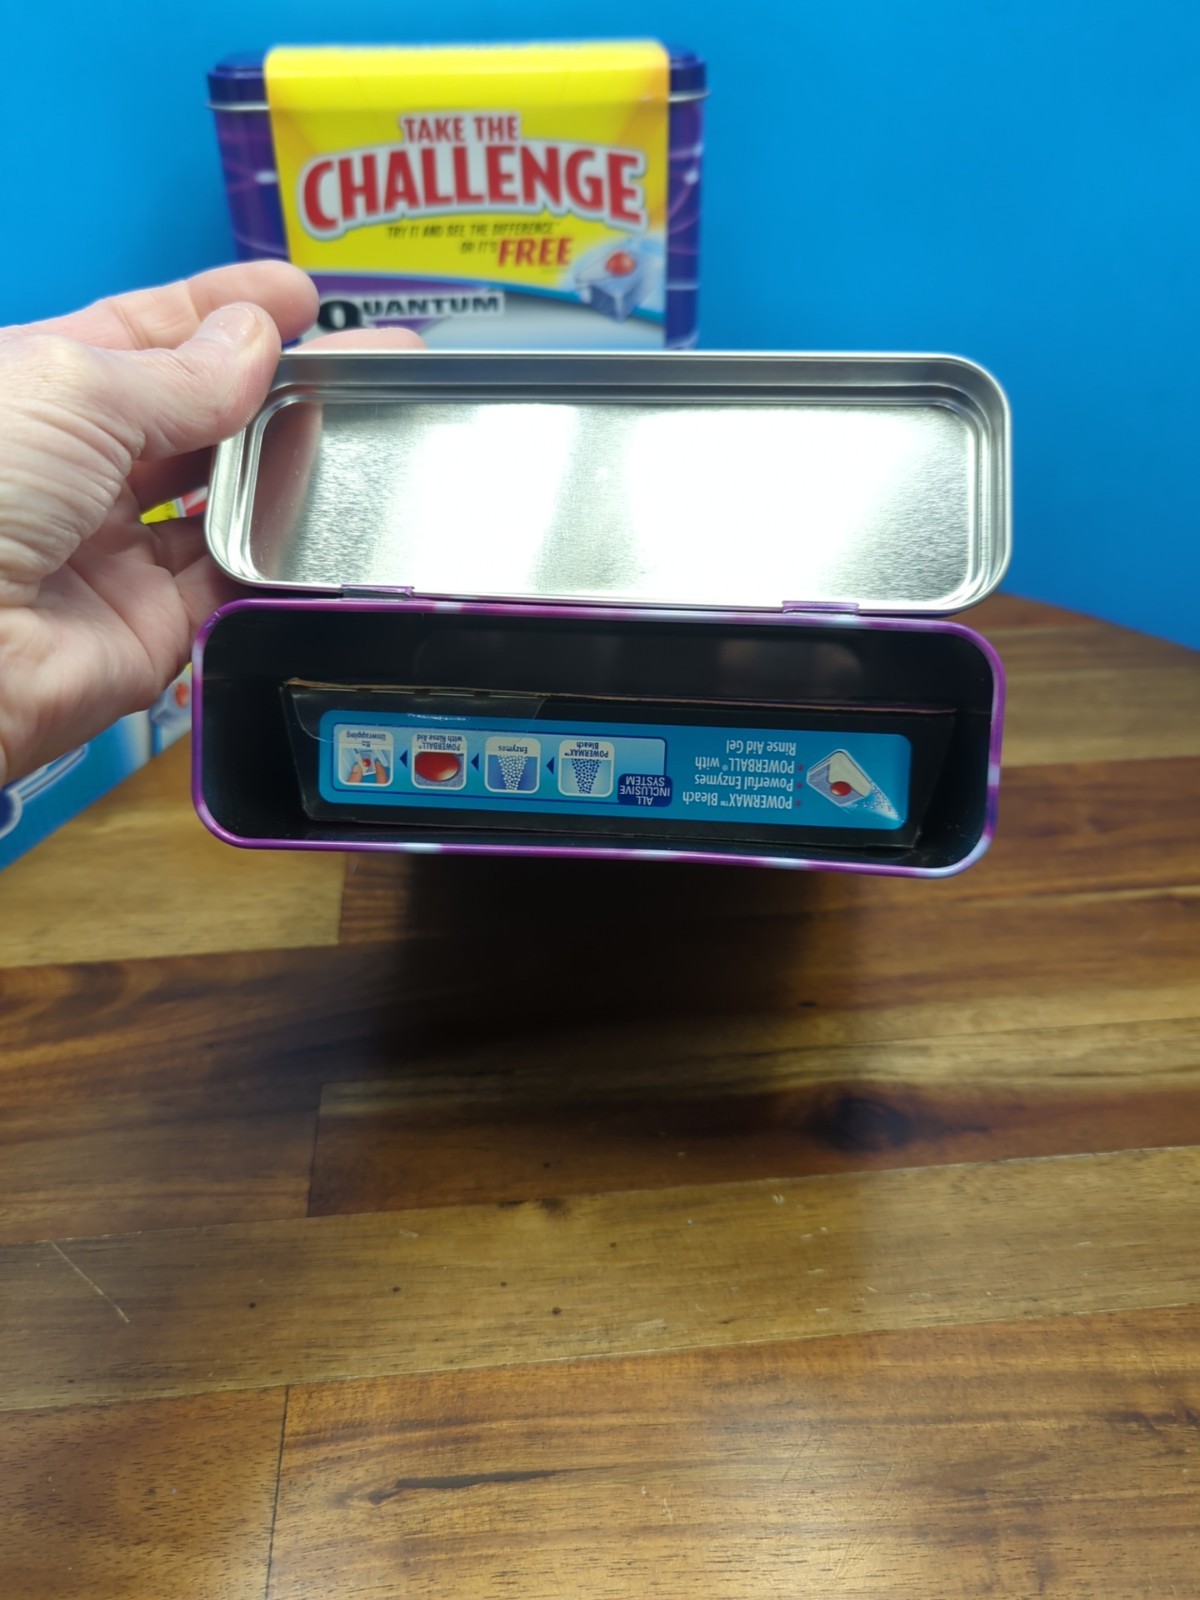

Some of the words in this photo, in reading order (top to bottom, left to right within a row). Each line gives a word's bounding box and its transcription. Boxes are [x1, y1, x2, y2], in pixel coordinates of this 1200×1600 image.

[404, 115, 464, 143] TAKE
[473, 114, 519, 141] THE
[303, 145, 643, 231] CHALLENGE
[423, 225, 444, 236] AND
[471, 223, 489, 236] THE
[497, 237, 573, 268] FREE
[346, 731, 387, 740] Unwrapping
[498, 744, 528, 754] Enzymes
[725, 739, 743, 753] Gel
[745, 741, 765, 755] Aid
[765, 742, 797, 756] Rinse
[694, 756, 720, 769] with
[625, 775, 666, 787] SYSTEM
[694, 773, 743, 789] Enzymes
[746, 776, 794, 792] Powerful
[619, 785, 671, 798] INCLUSIVE
[635, 795, 654, 806] ALL
[682, 791, 719, 807] Bleach
